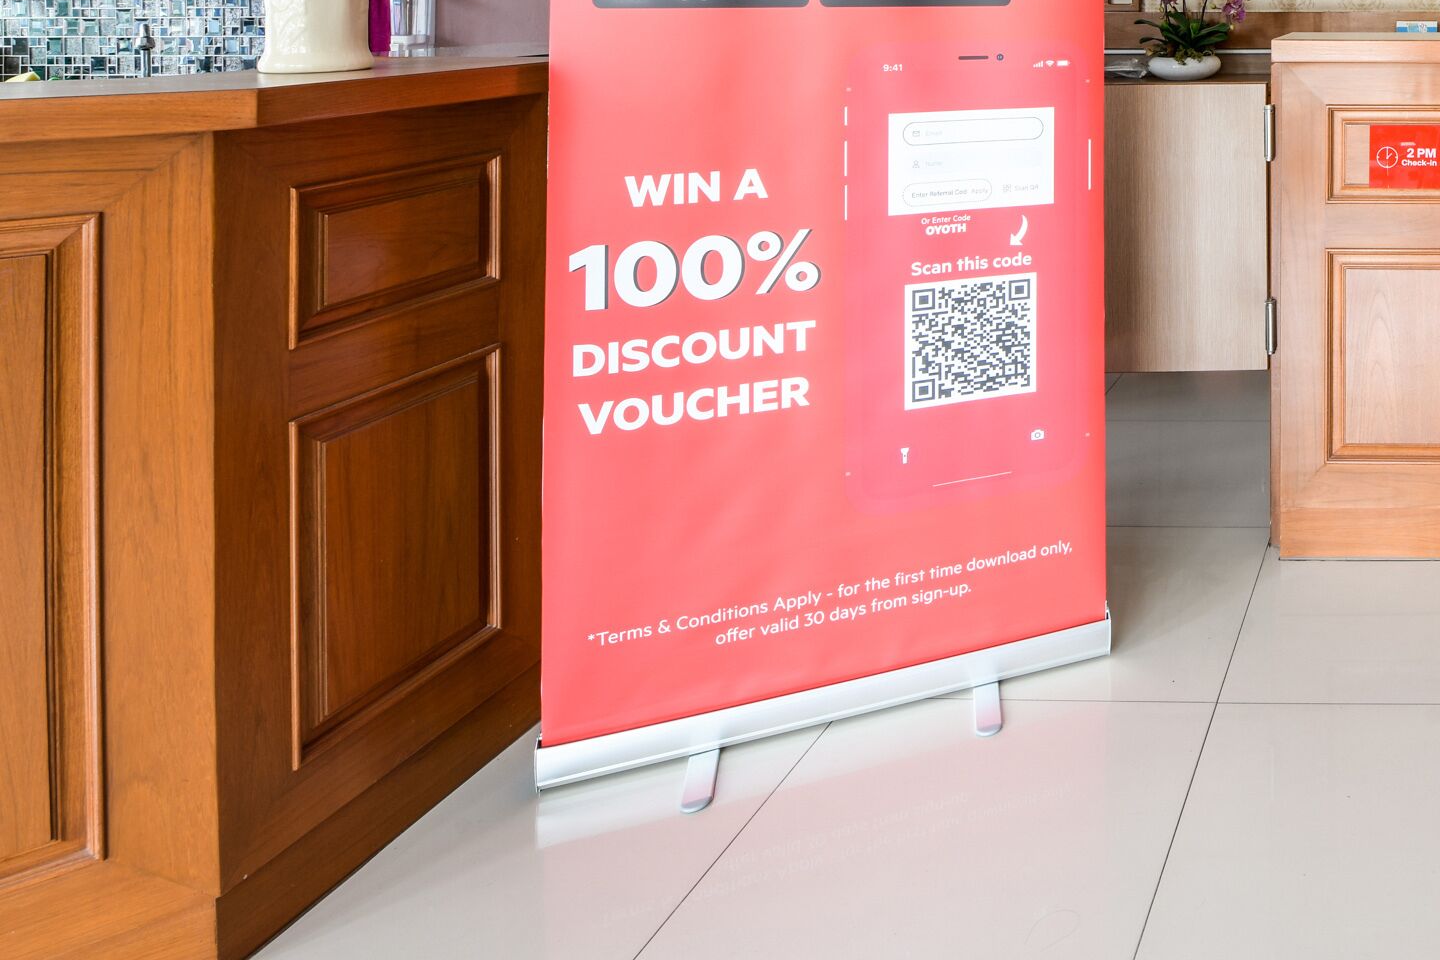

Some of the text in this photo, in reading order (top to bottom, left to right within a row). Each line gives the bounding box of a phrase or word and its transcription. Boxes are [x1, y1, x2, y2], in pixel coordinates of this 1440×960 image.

[883, 64, 903, 72] 9:41
[1401, 159, 1437, 167] Check-in
[1407, 148, 1437, 158] 2 PM
[624, 168, 768, 207] WIN A
[921, 214, 971, 225] Or Enter Code
[925, 223, 967, 235] OYOTH
[567, 228, 822, 312] 100%
[911, 252, 1032, 276] Scan this code
[572, 320, 816, 378] DISCOUNT
[578, 376, 810, 435] VOUCHER
[658, 619, 671, 634] &
[676, 602, 768, 630] Conditions
[773, 590, 822, 612] Apply
[837, 582, 860, 598] for
[864, 576, 890, 592] the
[895, 569, 925, 586] first
[929, 563, 962, 579] time
[966, 546, 1037, 572] download
[1040, 540, 1073, 556] only,
[715, 582, 972, 645] offer valid 30 days from sign-up.
